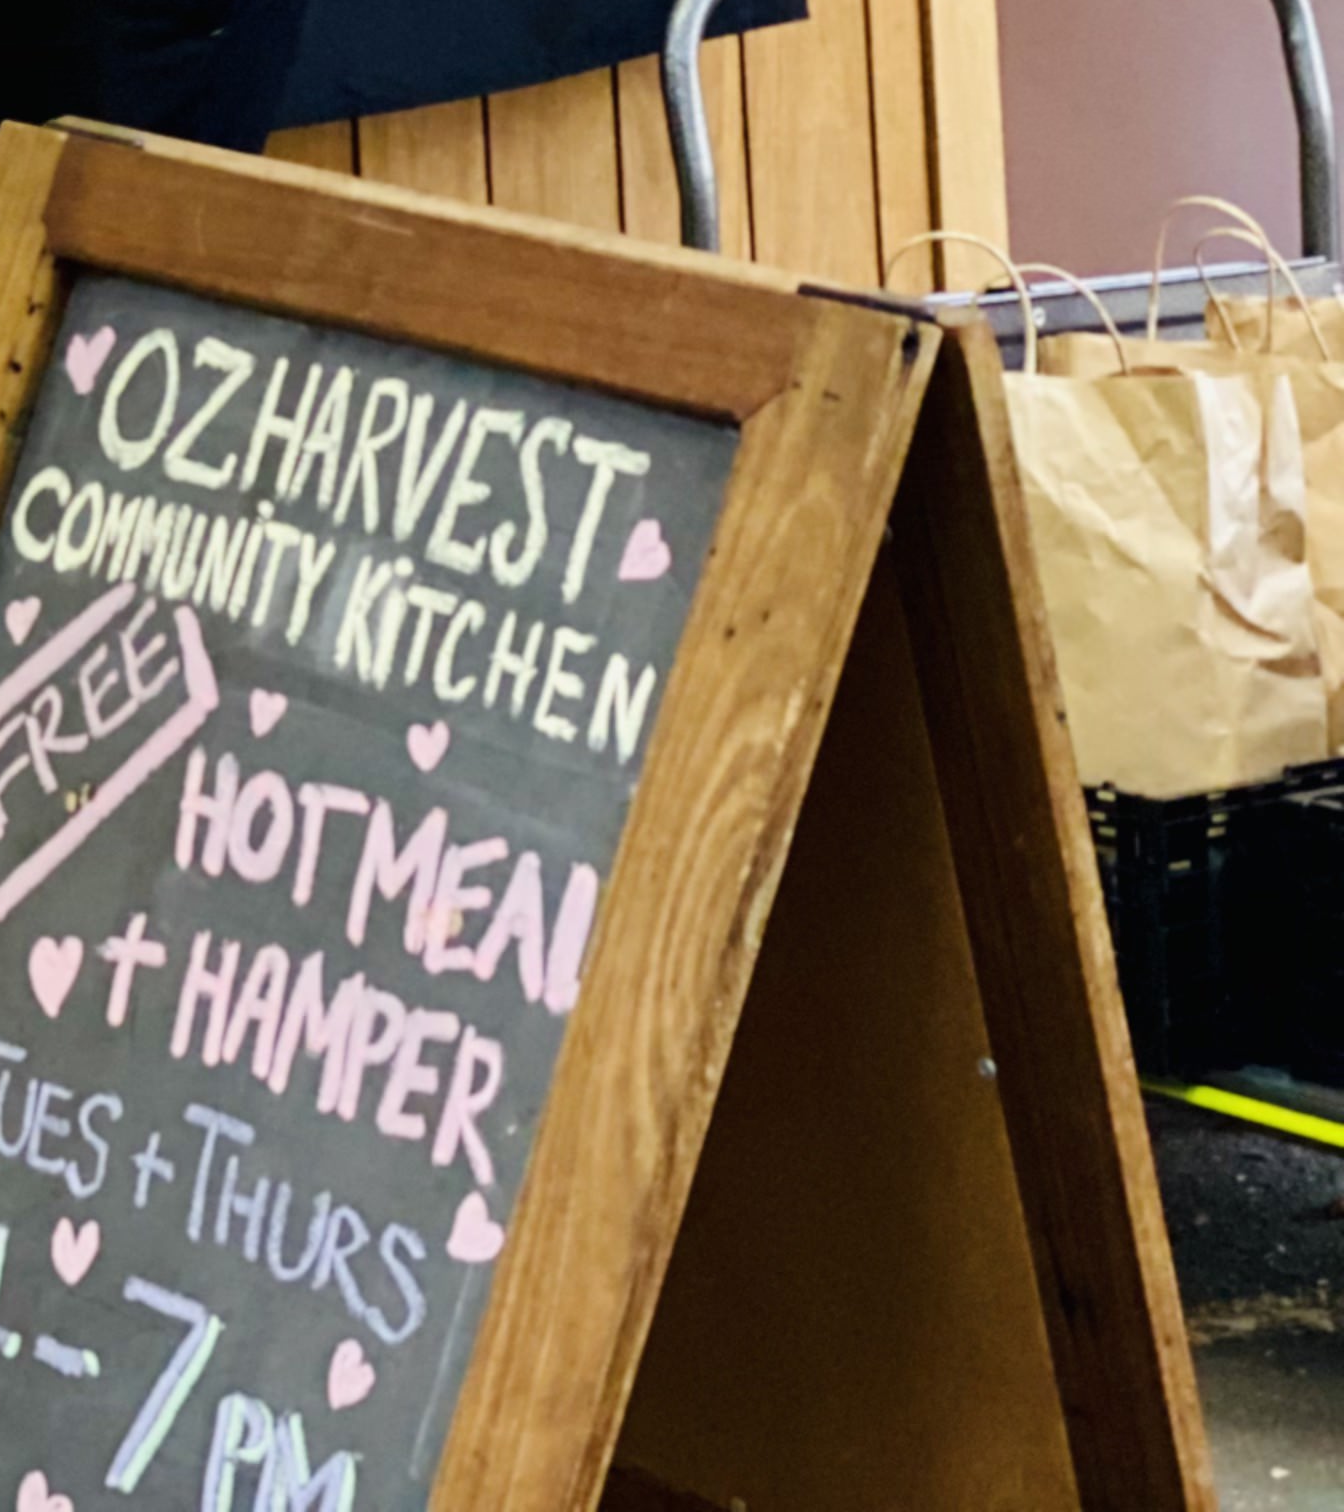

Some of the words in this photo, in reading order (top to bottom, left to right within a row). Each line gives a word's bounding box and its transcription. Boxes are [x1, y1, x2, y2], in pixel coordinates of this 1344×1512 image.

[10, 465, 338, 646] COMMUNITY
[98, 327, 652, 604] OZHARVEST
[174, 744, 371, 908] HOT
[345, 797, 600, 1016] MEAL
[169, 929, 504, 1187] HAMPER
[183, 1102, 426, 1345] THURS
[201, 1390, 363, 1512] PM
